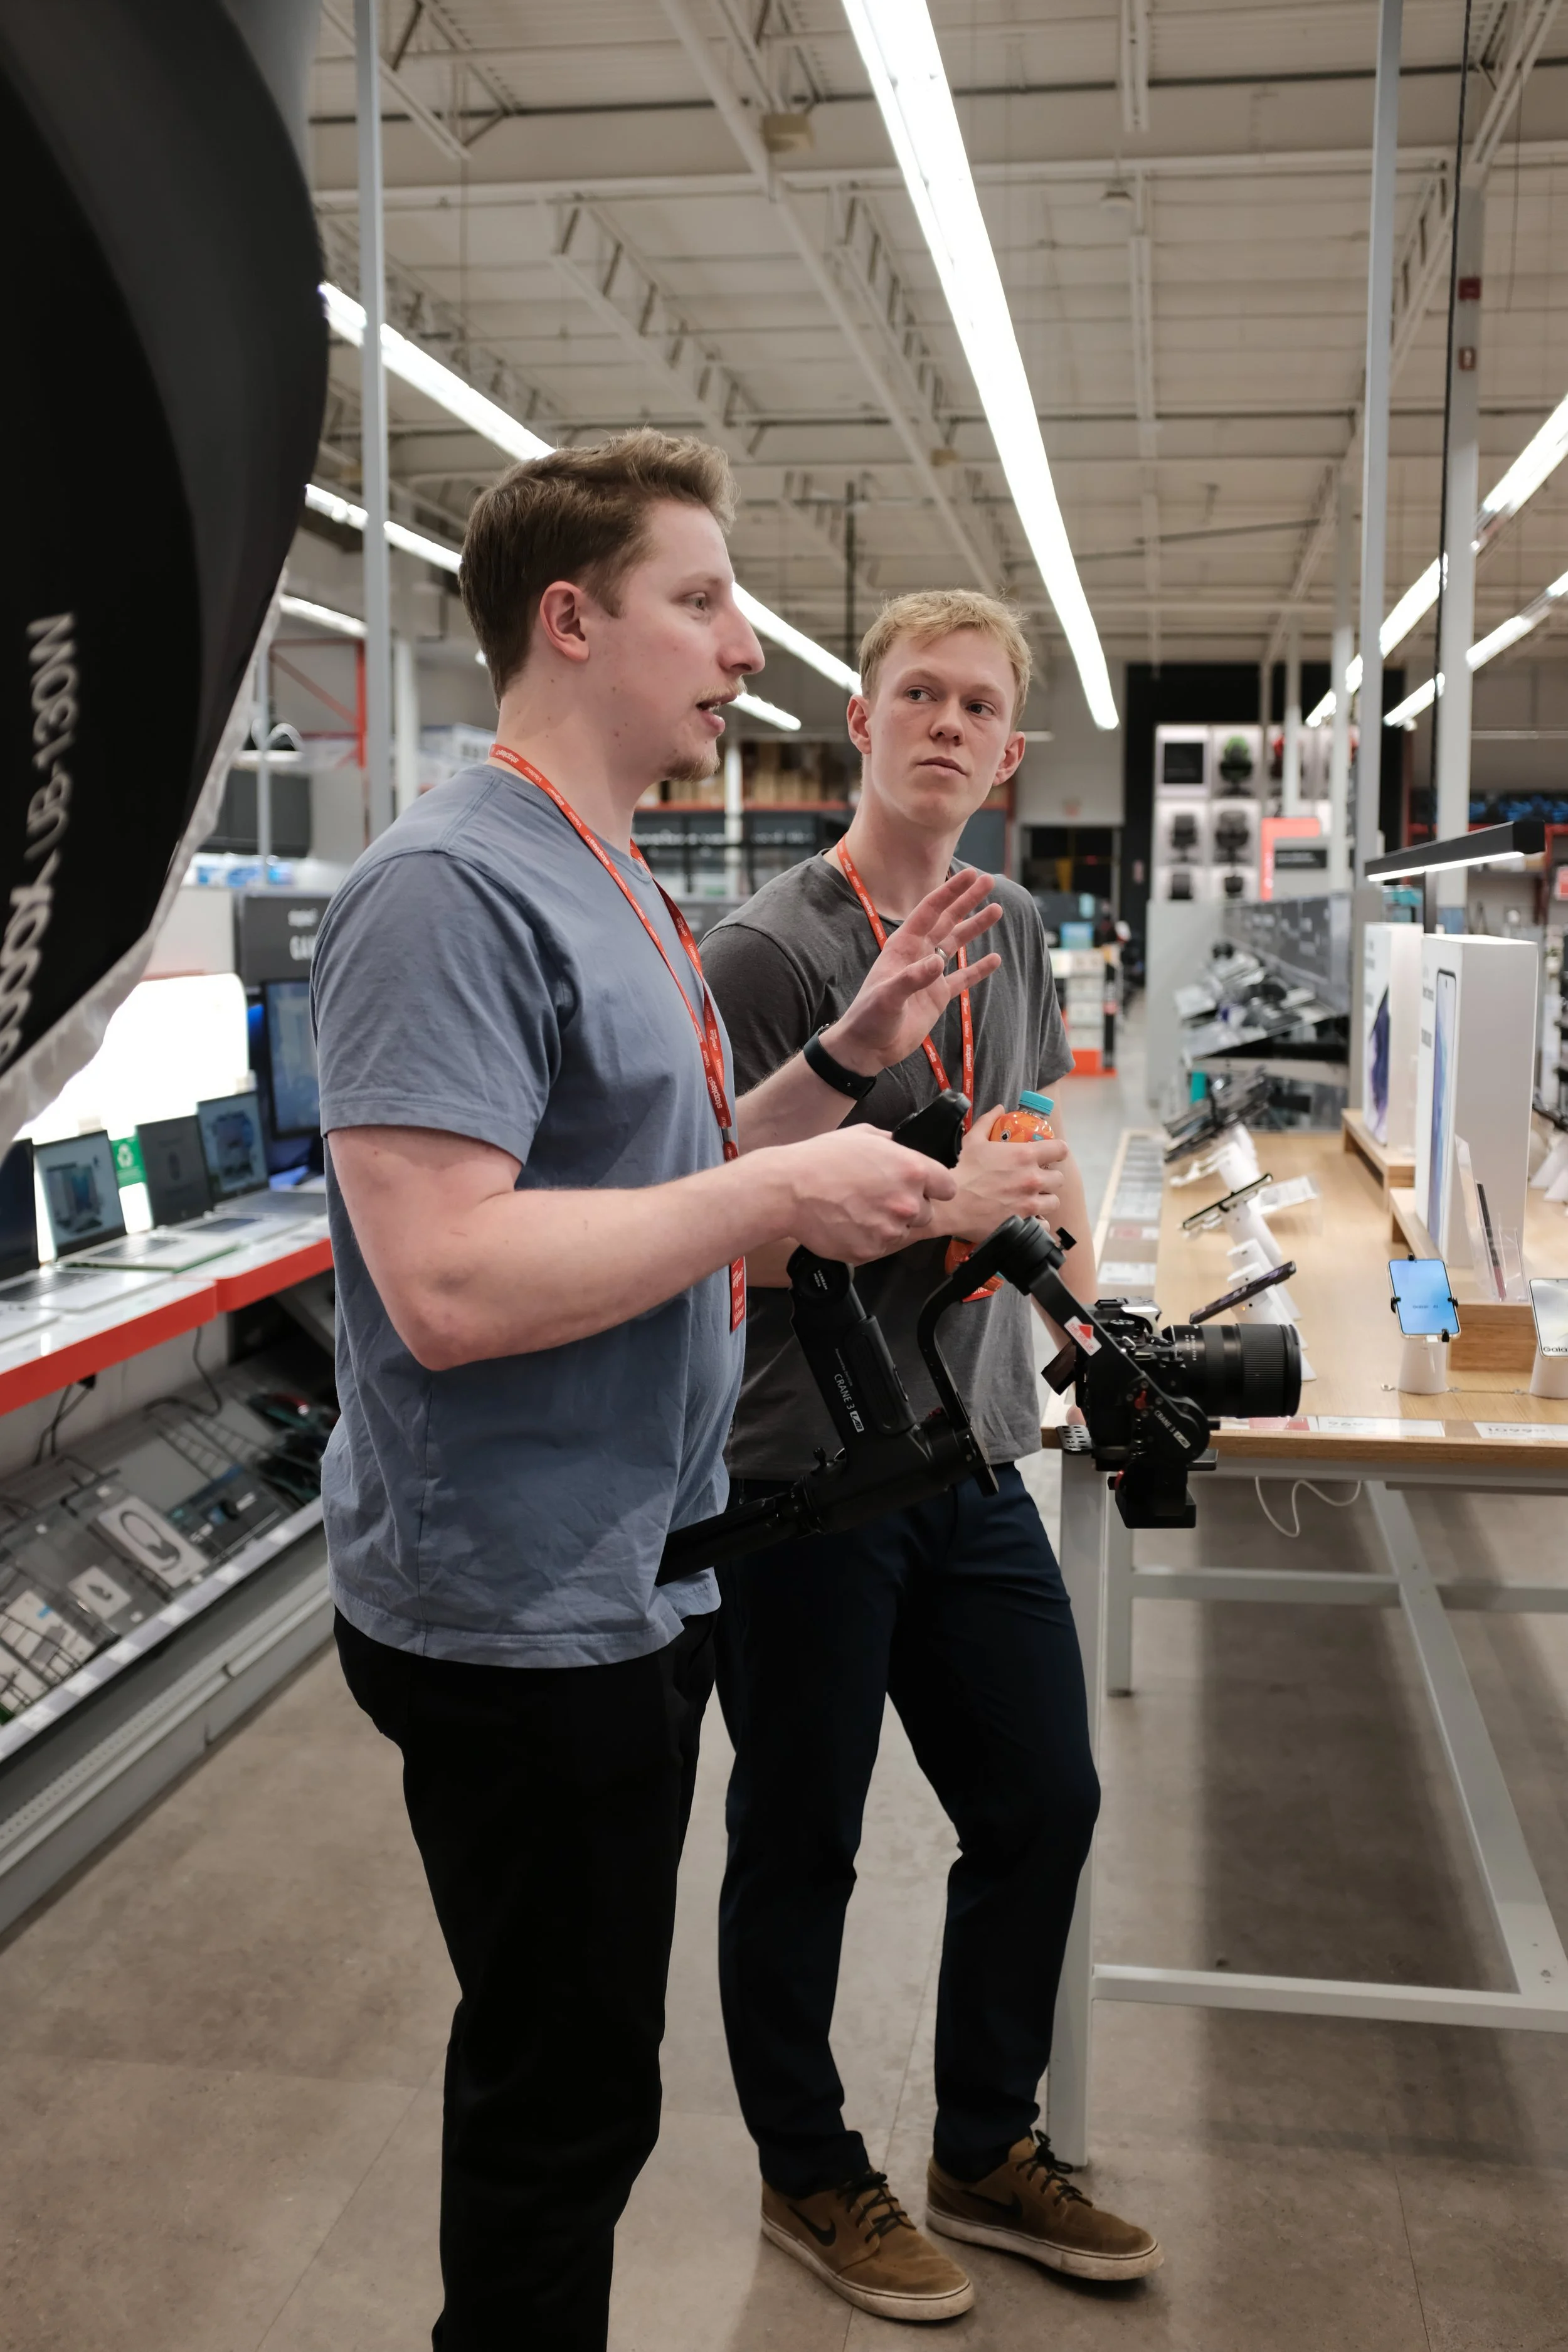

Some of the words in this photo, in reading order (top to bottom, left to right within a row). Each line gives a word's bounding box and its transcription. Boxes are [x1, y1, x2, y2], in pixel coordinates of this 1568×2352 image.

[24, 610, 80, 861] UB-130W
[568, 812, 582, 828] Visitor
[588, 838, 610, 866] staples
[862, 896, 875, 918] staples
[710, 1080, 723, 1109] staples
[834, 1374, 852, 1403] CRANE
[851, 1412, 863, 1431] LAB
[1155, 1410, 1172, 1428] CRANE
